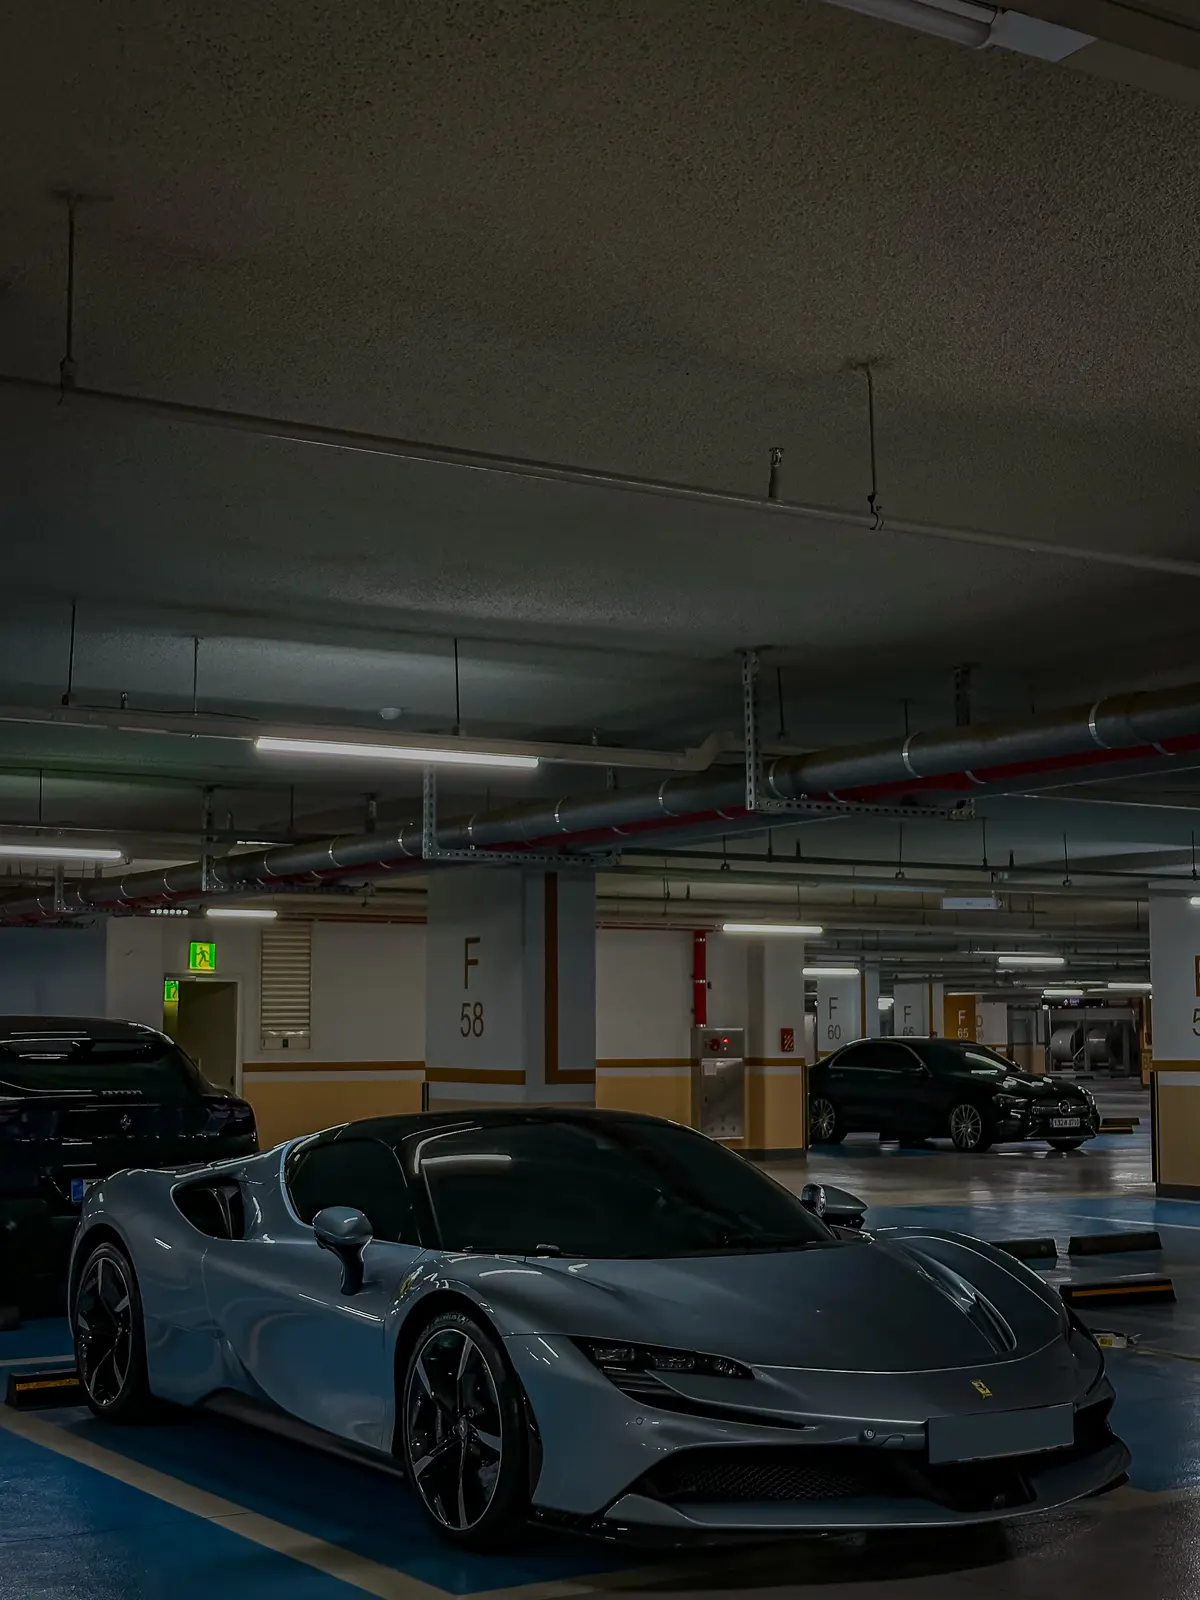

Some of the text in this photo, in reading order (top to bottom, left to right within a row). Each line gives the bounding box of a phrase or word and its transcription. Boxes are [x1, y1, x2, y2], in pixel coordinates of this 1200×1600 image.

[464, 937, 481, 990] F
[828, 997, 839, 1020] F
[903, 1005, 912, 1023] F
[957, 1009, 967, 1026] F
[460, 1001, 484, 1038] 58
[827, 1024, 842, 1040] 60
[957, 1027, 969, 1039] 65
